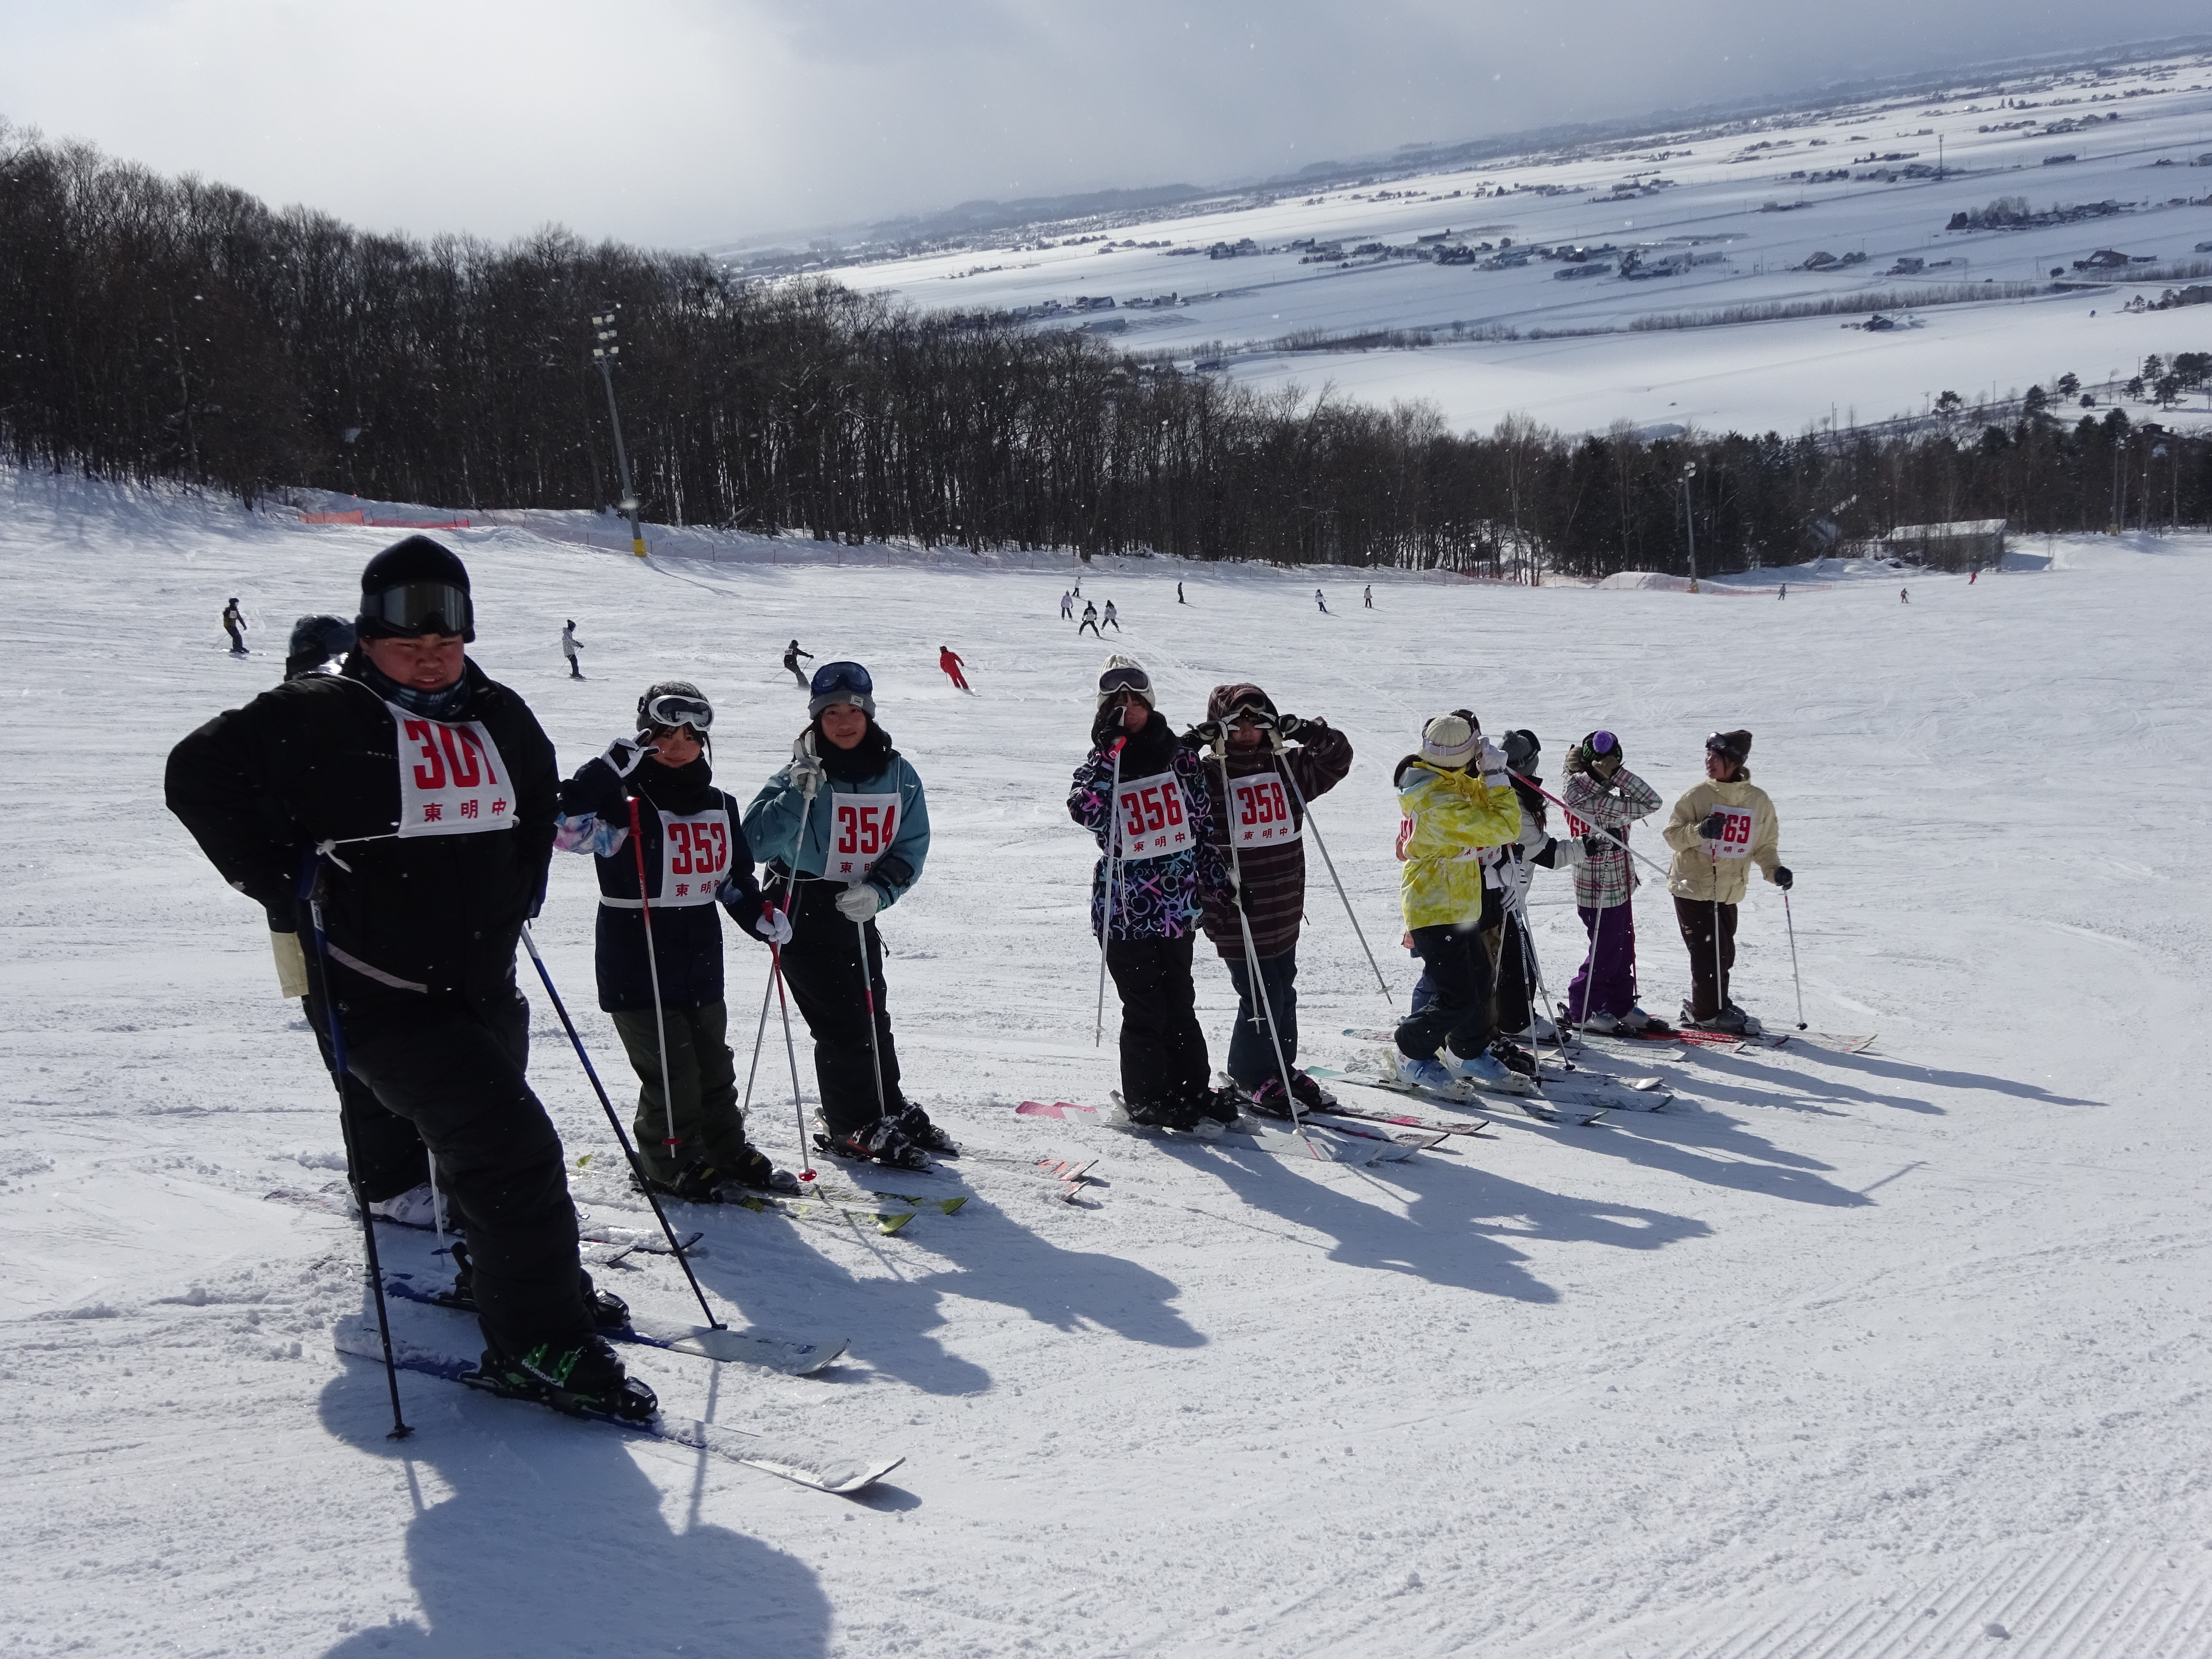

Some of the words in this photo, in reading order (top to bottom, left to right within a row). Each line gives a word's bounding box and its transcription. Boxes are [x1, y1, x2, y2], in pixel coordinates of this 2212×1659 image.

[404, 720, 497, 789] 301
[422, 798, 506, 822] 東明中
[1120, 782, 1183, 836] 356
[1237, 783, 1286, 825] 358
[839, 805, 895, 853] 354
[1134, 832, 1186, 852] 東明中
[1243, 826, 1288, 840] 東明中
[1714, 812, 1751, 844] 69
[668, 823, 726, 874] 353
[521, 1359, 564, 1387] NORDICA
